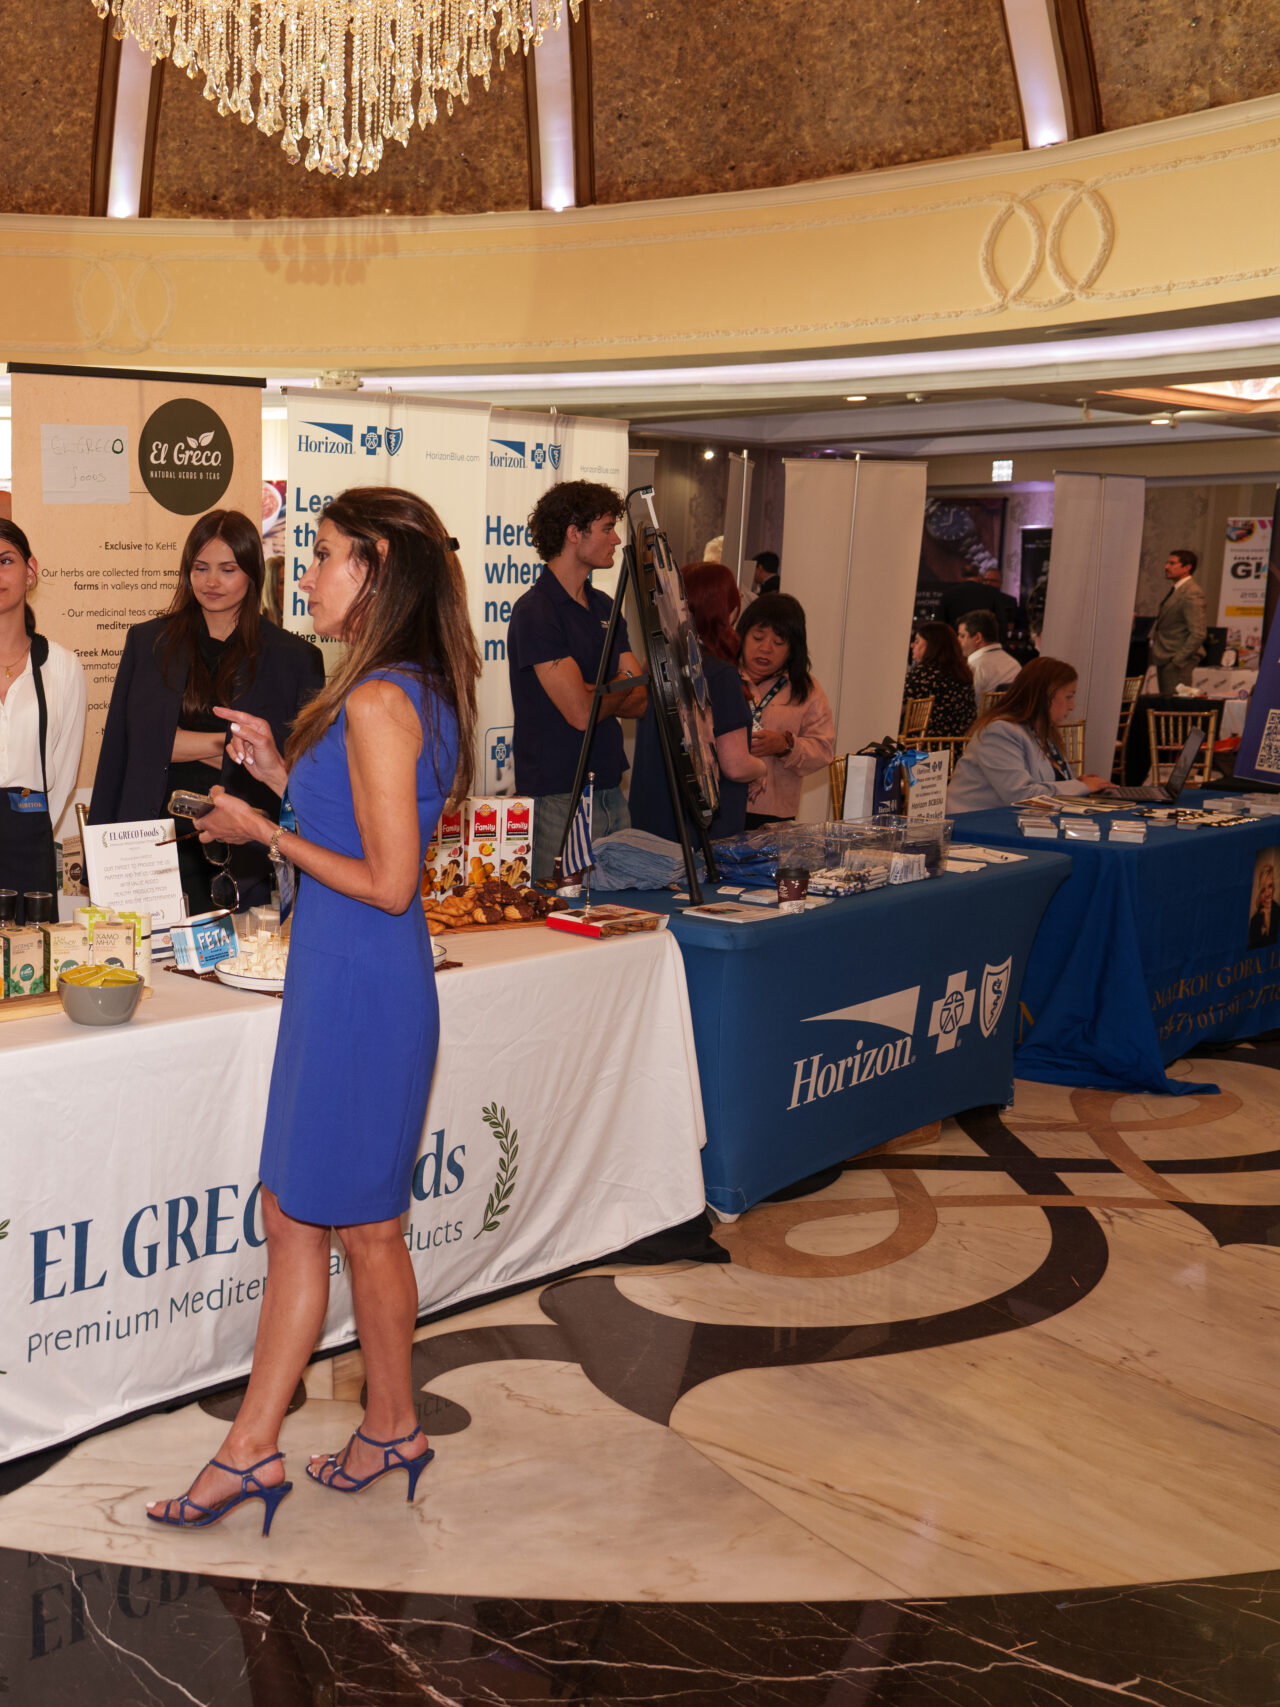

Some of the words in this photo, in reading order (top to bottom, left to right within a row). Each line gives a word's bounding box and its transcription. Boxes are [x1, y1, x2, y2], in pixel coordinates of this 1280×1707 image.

[297, 434, 354, 455] Horizon
[150, 441, 169, 465] El
[173, 441, 222, 467] Greco
[425, 450, 481, 462] HorizonBlue.com
[104, 541, 143, 551] Exclusive
[144, 542, 154, 550] to
[155, 541, 178, 551] KeHE
[41, 568, 58, 578] Our
[60, 567, 84, 577] herbs
[102, 567, 139, 577] collected
[141, 567, 161, 577] from
[73, 581, 99, 590] farms
[101, 581, 109, 590] in
[110, 581, 139, 591] valleys
[140, 580, 158, 590] and
[67, 608, 84, 618] Our
[86, 608, 127, 617] medicinal
[128, 608, 147, 617] teas
[118, 830, 139, 840] GRECO
[140, 828, 160, 838] Foods
[196, 927, 231, 952] FETA
[787, 1037, 913, 1111] Horizon
[29, 1218, 108, 1304] EL
[121, 1182, 269, 1280] GREC
[26, 1303, 160, 1362] Premium
